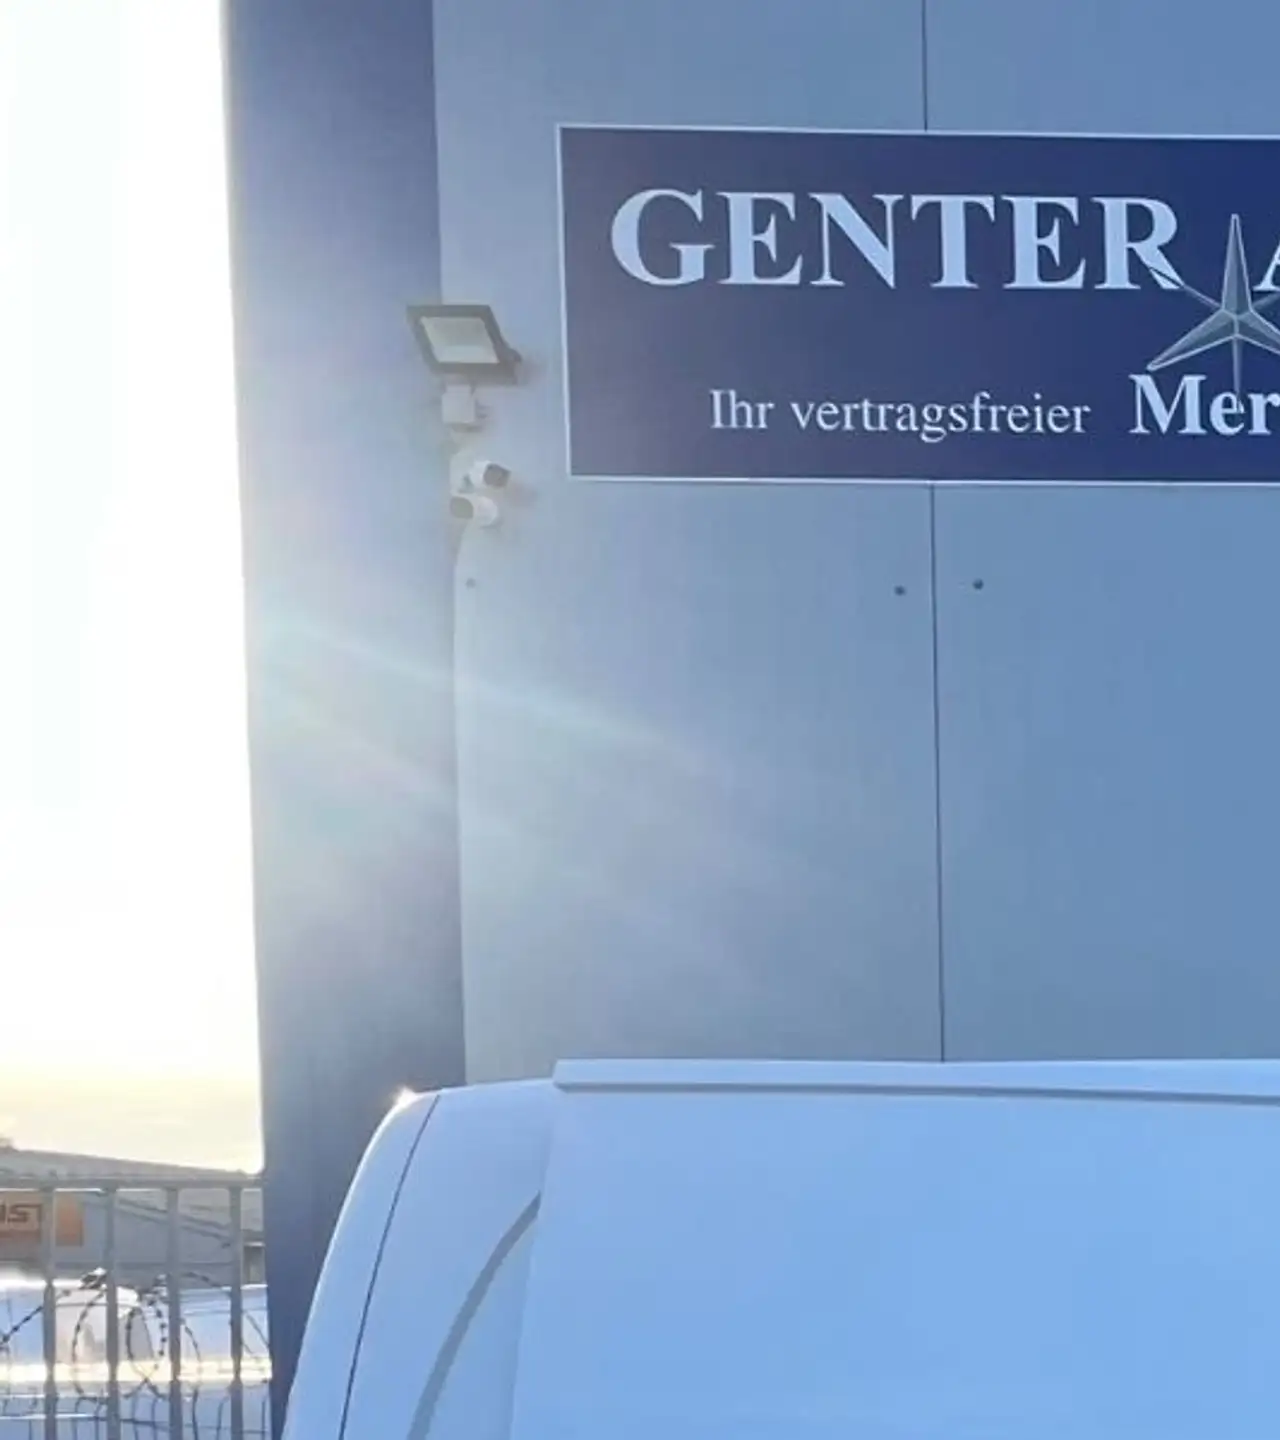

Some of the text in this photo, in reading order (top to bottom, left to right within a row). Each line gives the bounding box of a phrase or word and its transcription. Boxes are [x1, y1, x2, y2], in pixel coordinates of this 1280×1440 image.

[610, 188, 1184, 290] GENTER
[710, 389, 775, 429] Ihr
[789, 391, 1092, 443] vertragsfreier
